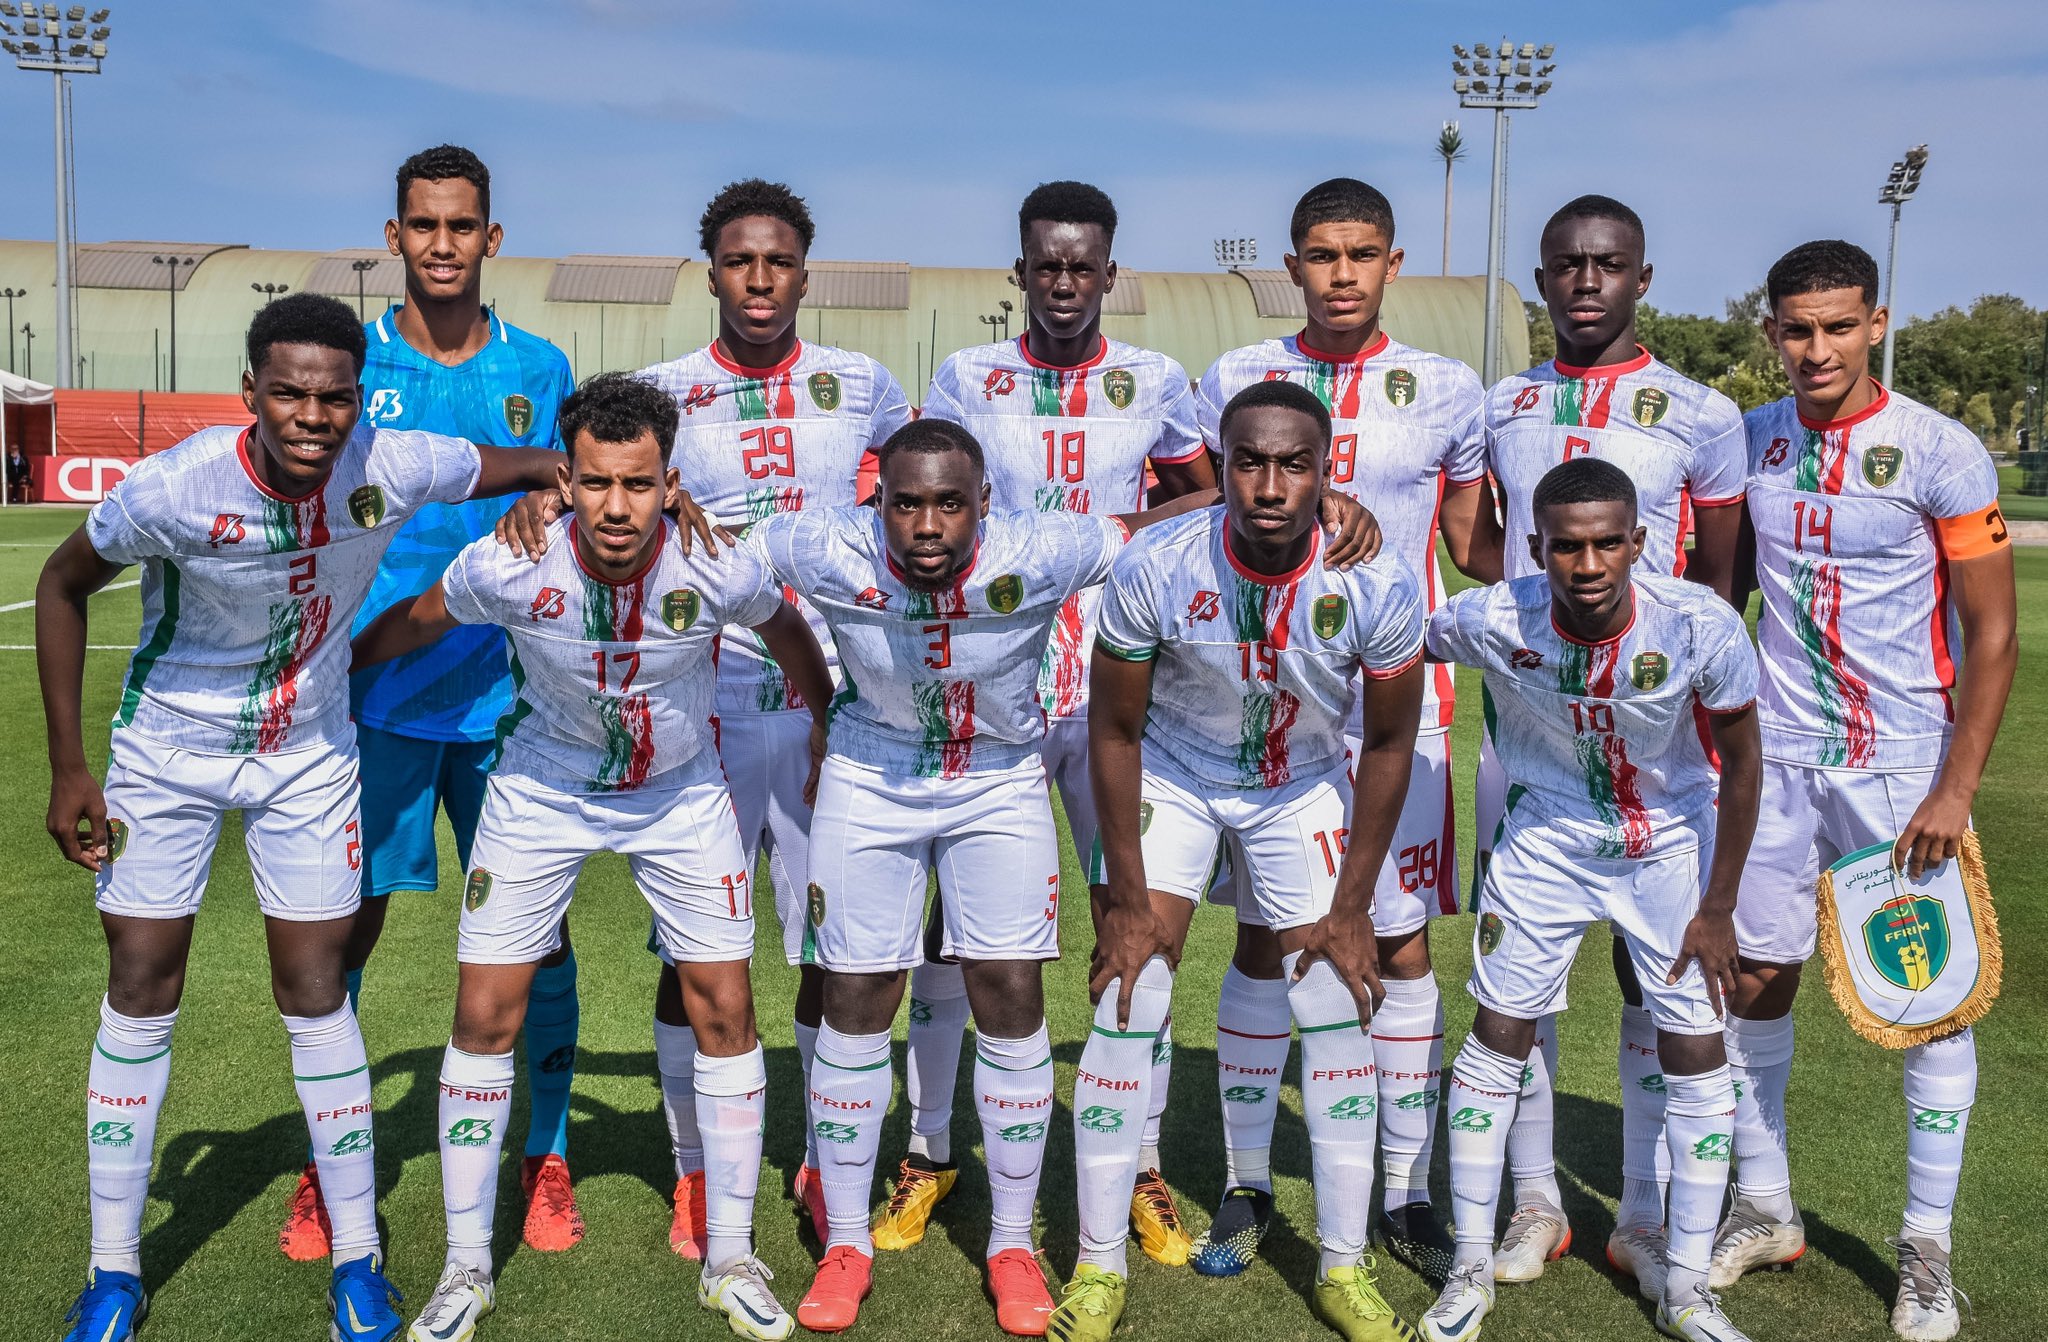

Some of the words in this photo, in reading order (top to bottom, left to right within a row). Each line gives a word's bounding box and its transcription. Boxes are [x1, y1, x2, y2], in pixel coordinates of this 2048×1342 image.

[740, 425, 796, 480] 29
[1042, 429, 1086, 484] 18
[58, 458, 143, 502] CD
[1793, 500, 1834, 557] 14
[289, 553, 317, 597] 2
[922, 622, 952, 669] 3
[1237, 642, 1278, 684] 19
[591, 651, 641, 694] 17
[1567, 702, 1615, 736] 10
[1399, 838, 1438, 894] 28
[1045, 874, 1059, 921] 3
[1884, 921, 1930, 943] FFRIM
[88, 1089, 147, 1107] FRIM
[440, 1083, 508, 1102] FFRIM
[1703, 1154, 1731, 1162] SPOR
